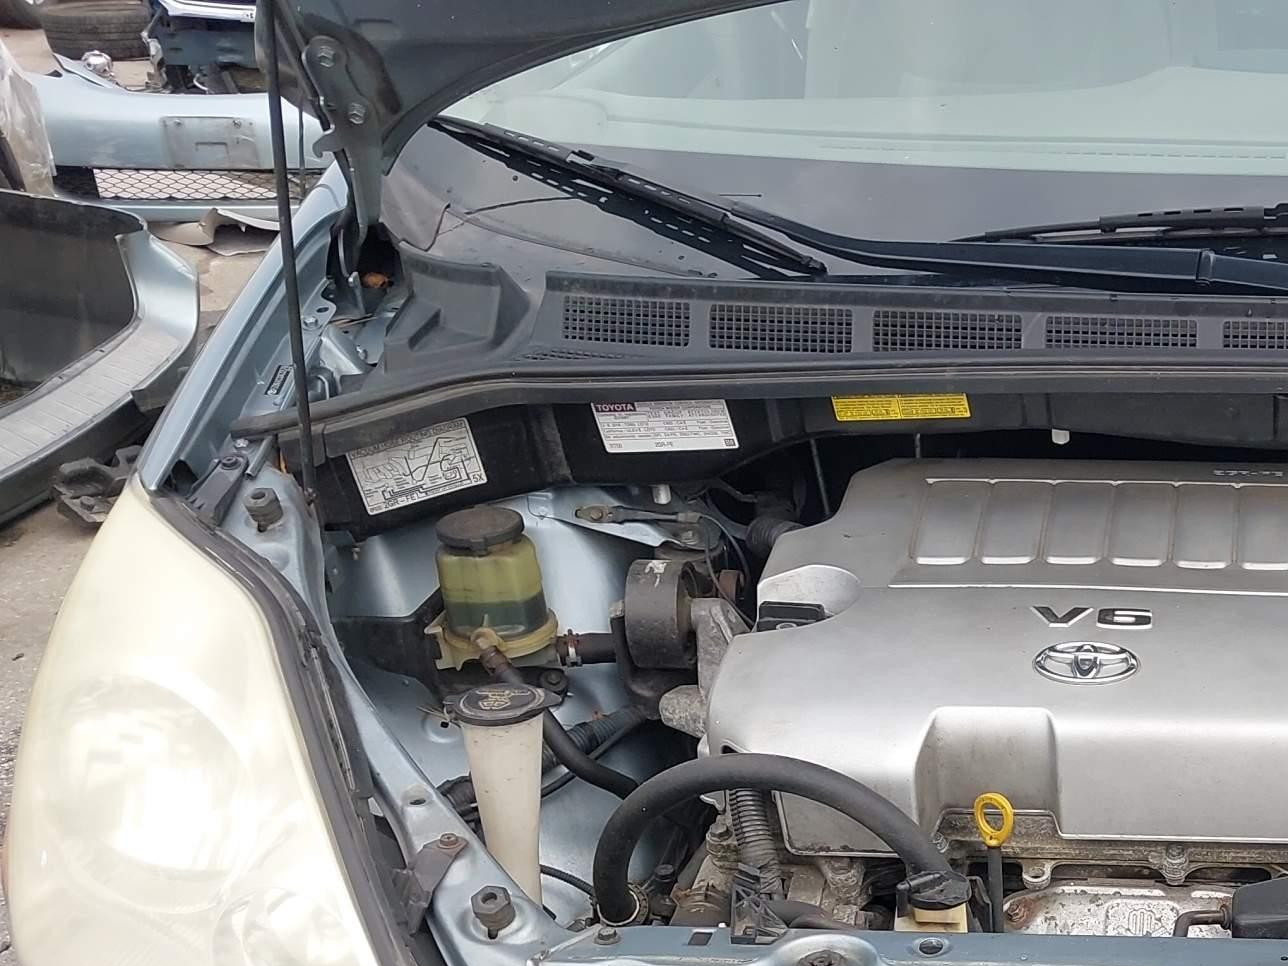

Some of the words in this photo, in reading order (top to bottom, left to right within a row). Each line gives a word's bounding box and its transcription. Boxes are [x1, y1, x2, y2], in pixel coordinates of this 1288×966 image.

[596, 403, 635, 412] TOYOTA
[472, 473, 485, 483] 5X
[1030, 605, 1153, 630] V6
